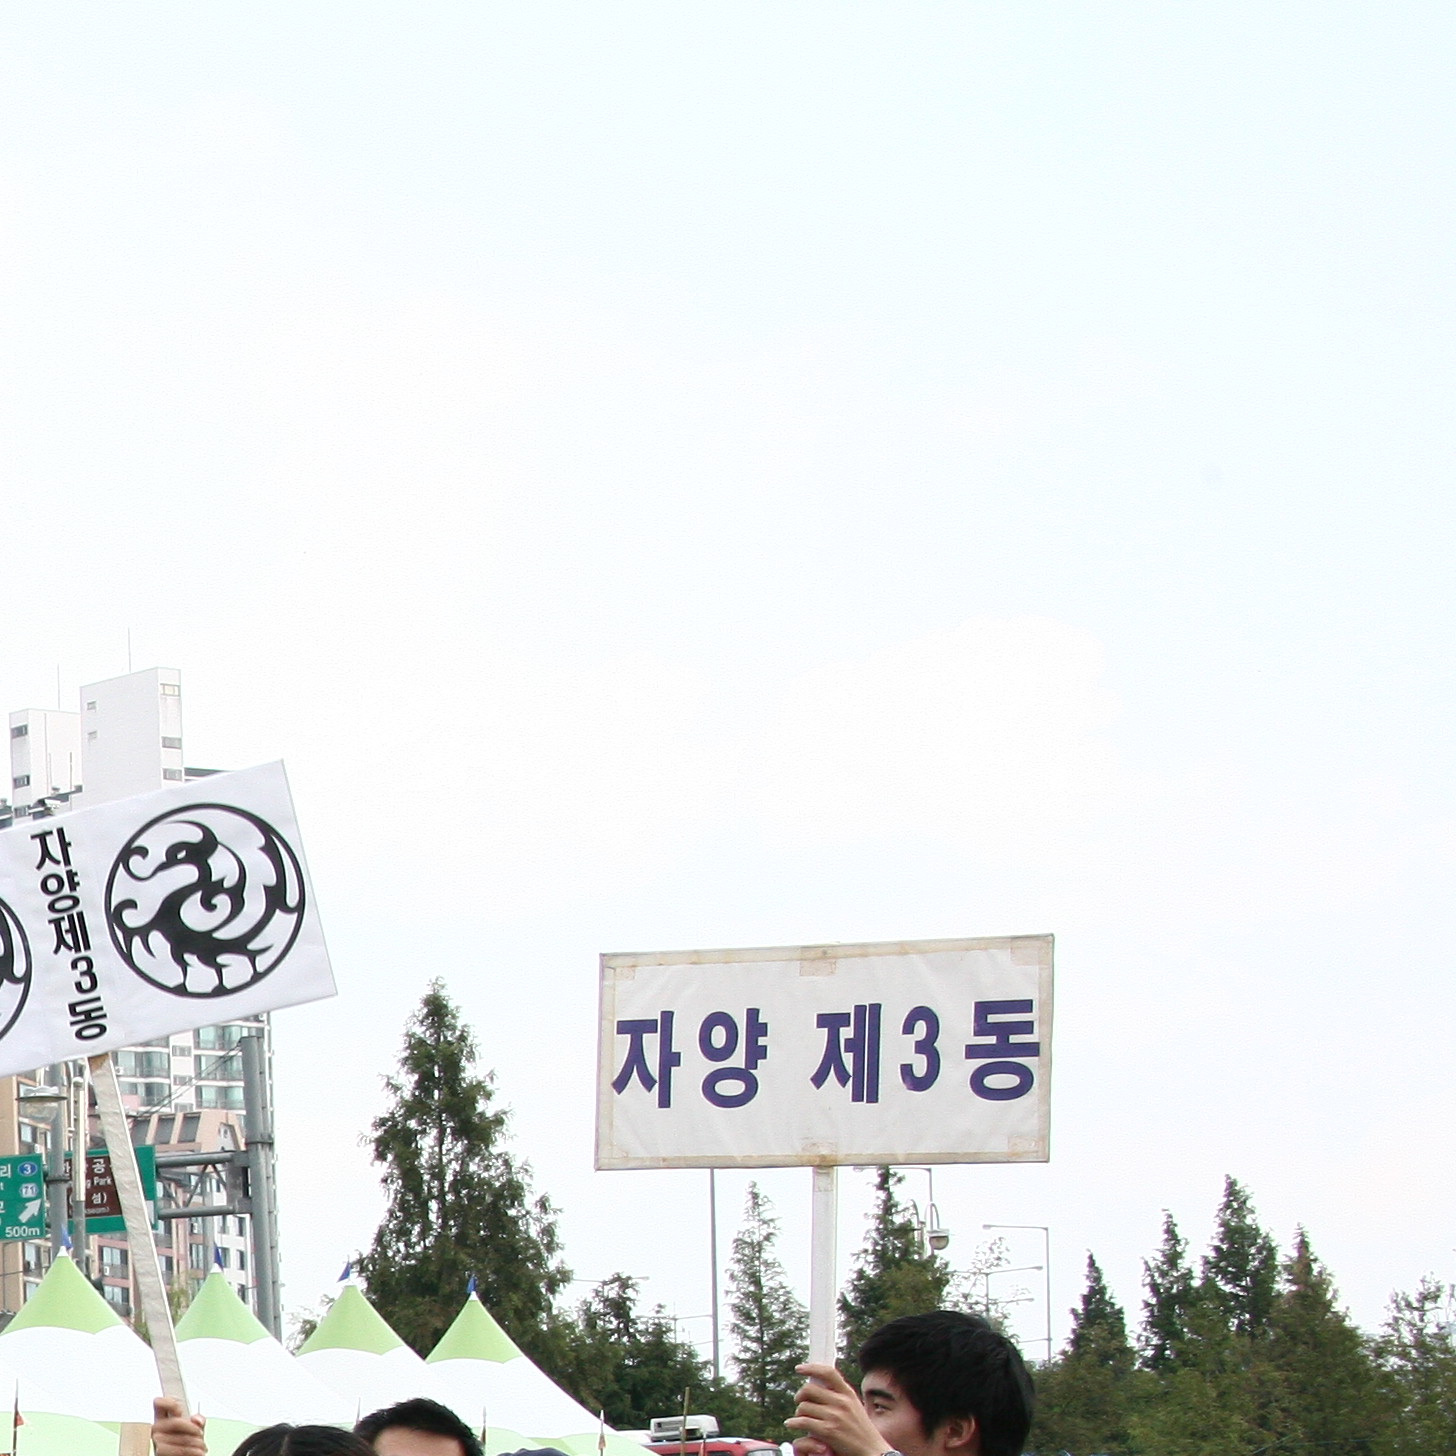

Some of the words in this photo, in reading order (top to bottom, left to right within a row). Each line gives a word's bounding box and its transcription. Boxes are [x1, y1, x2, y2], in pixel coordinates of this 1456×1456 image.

[30, 827, 107, 1041] 자양제3동
[611, 1009, 768, 1109] 자양
[810, 999, 1040, 1104] 제3동
[24, 1164, 32, 1175] 3
[5, 1224, 40, 1238] 500m
